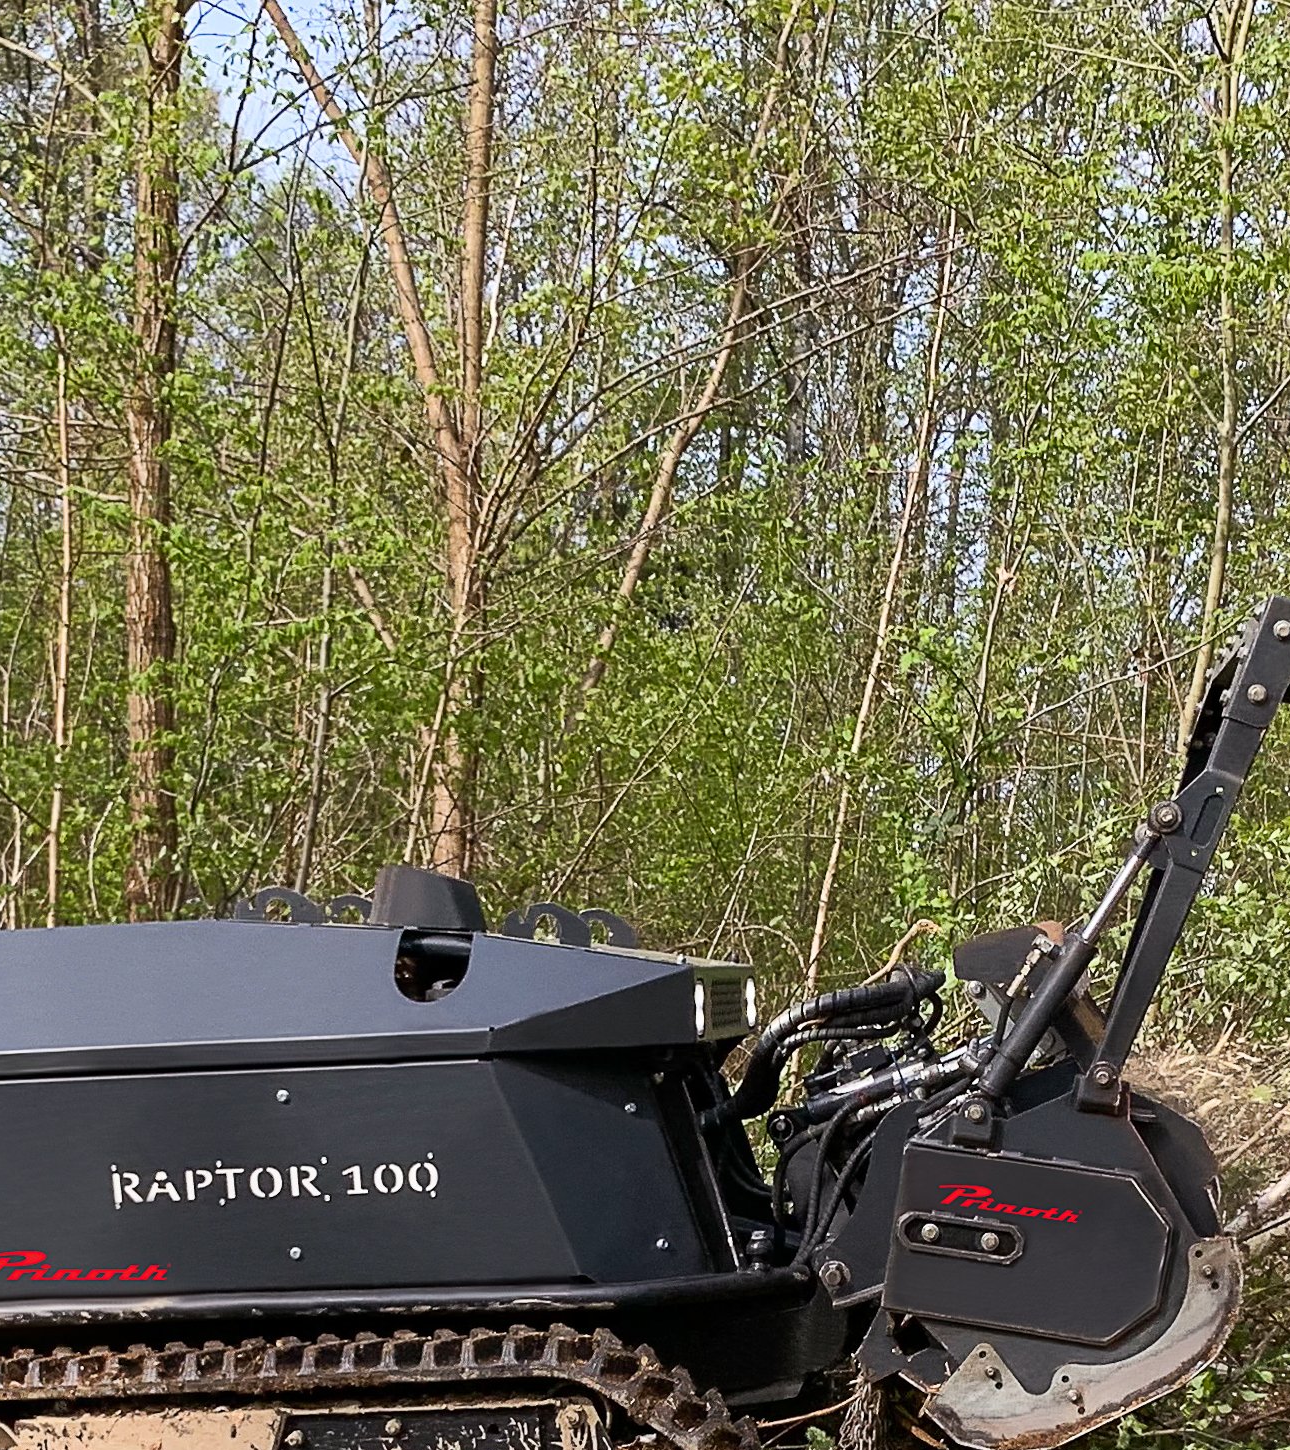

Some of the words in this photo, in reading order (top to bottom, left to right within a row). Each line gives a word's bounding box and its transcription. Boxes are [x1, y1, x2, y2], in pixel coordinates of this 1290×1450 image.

[110, 1163, 324, 1207] RAPTOR
[341, 1161, 440, 1196] 100
[938, 1184, 1079, 1224] Prinoth
